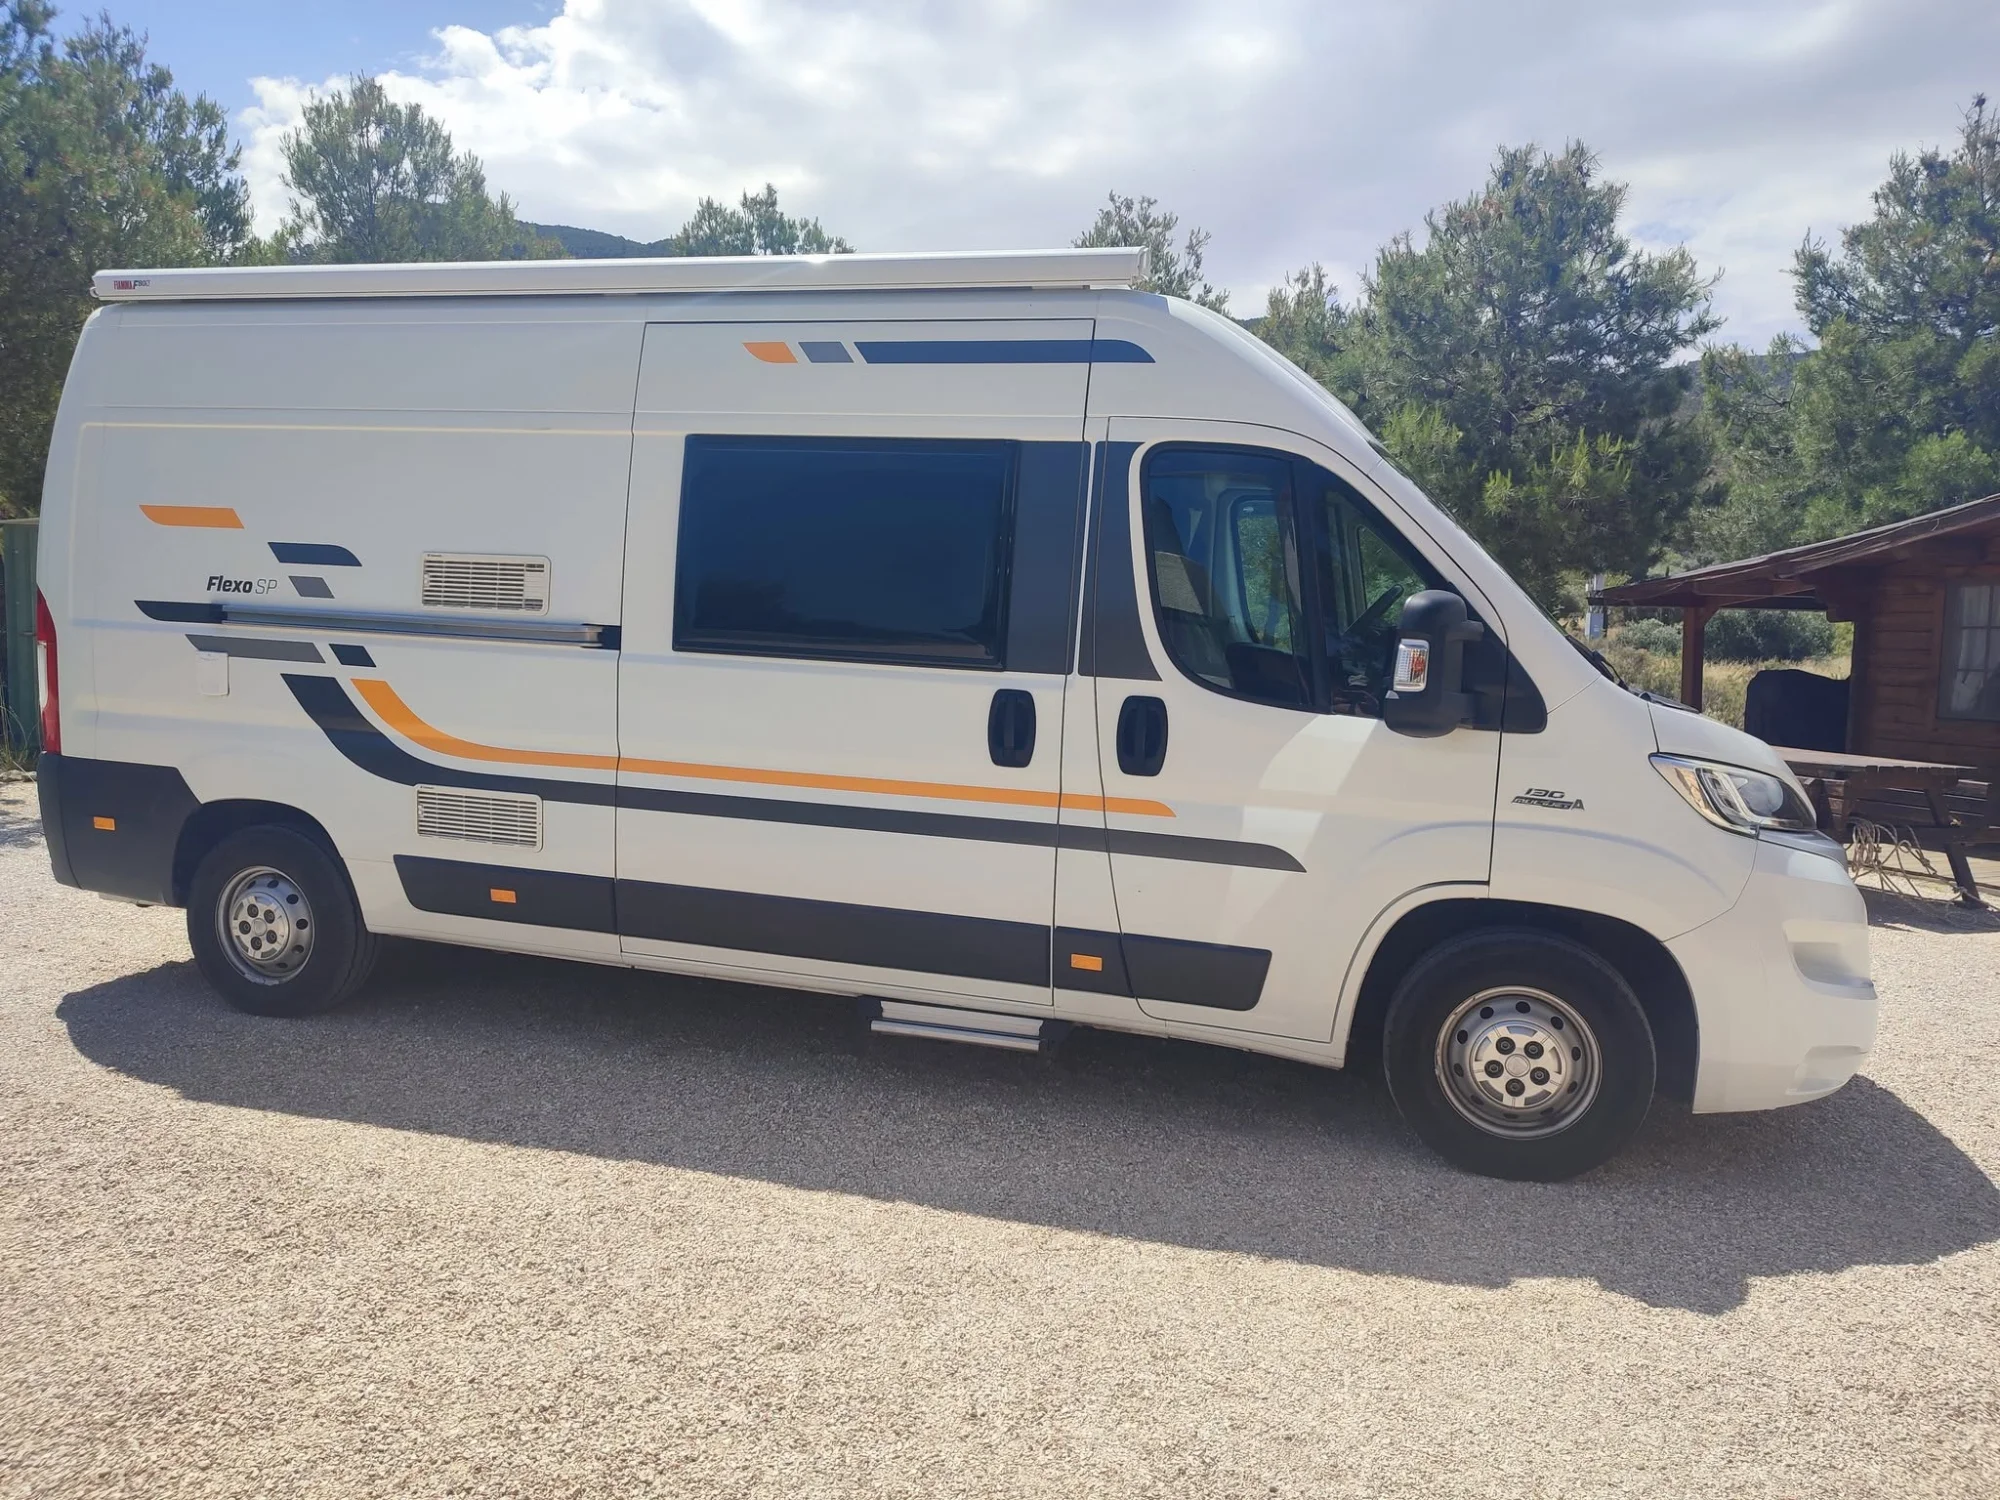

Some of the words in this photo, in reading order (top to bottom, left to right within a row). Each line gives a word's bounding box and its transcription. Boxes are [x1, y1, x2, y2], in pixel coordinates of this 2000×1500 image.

[206, 575, 253, 593] Flexo
[255, 578, 278, 594] SP
[1524, 787, 1565, 799] 130
